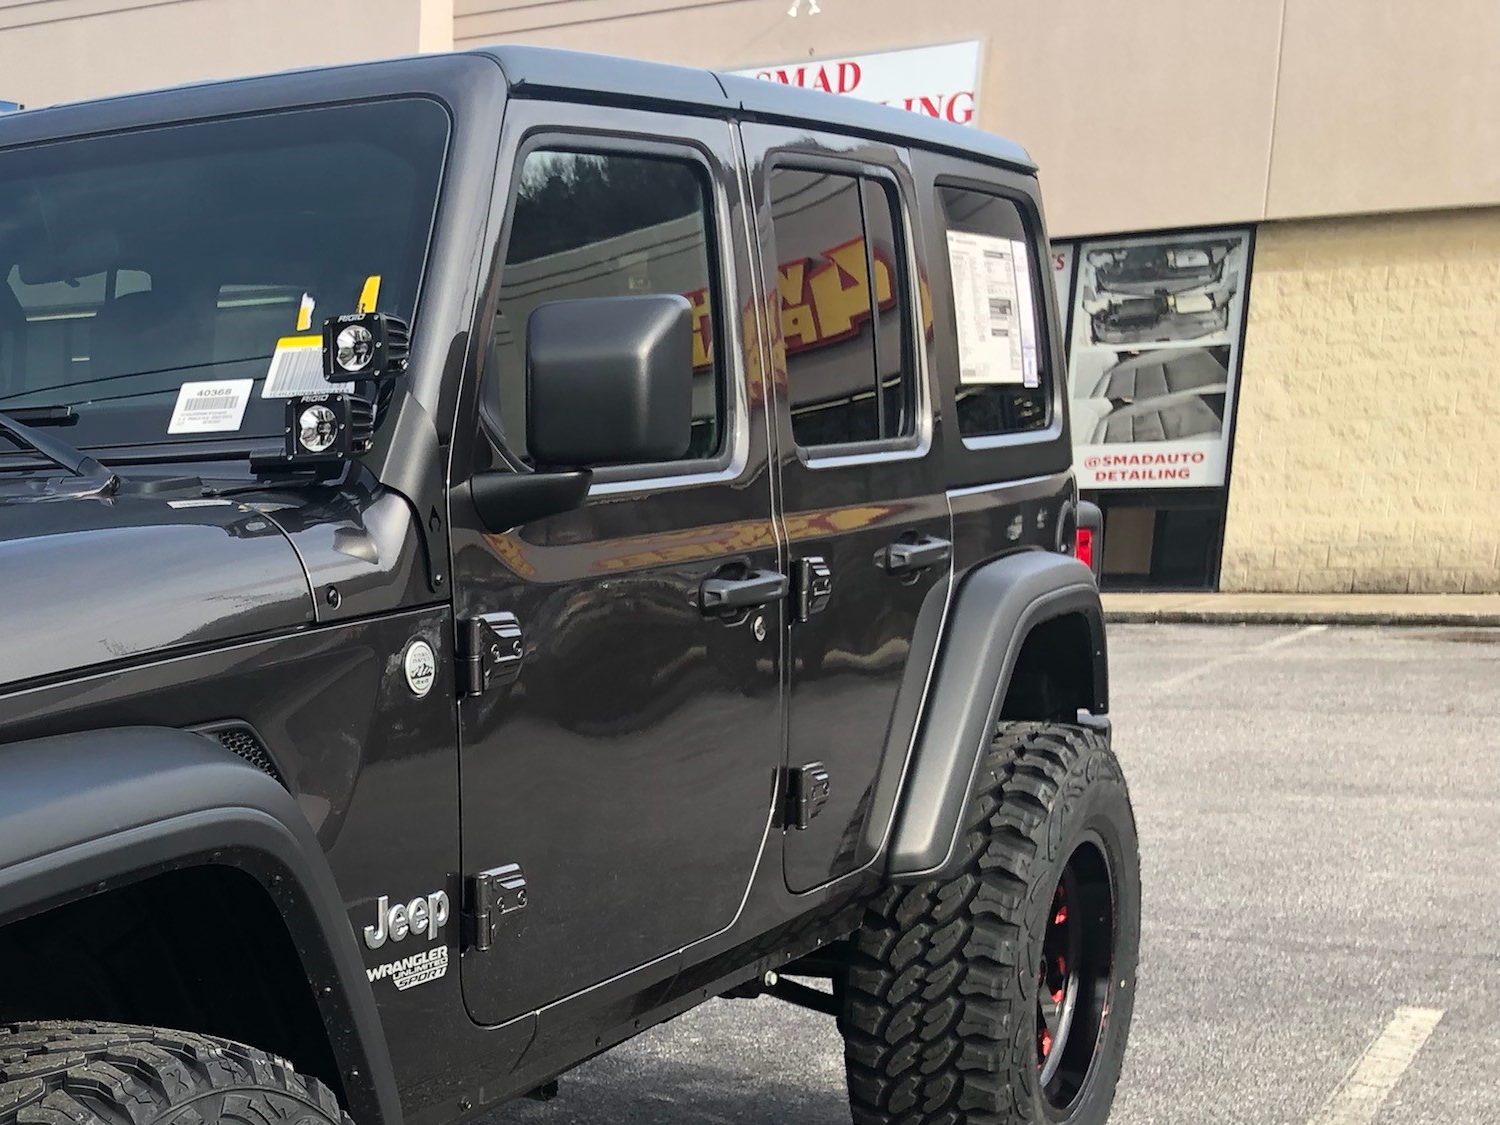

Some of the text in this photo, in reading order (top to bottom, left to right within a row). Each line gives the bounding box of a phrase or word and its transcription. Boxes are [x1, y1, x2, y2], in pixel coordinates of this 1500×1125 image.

[756, 61, 861, 94] MAD
[301, 394, 329, 403] RIGID
[1084, 451, 1204, 470] @SMADAUTO
[1095, 468, 1190, 482] DETAILING
[364, 889, 449, 949] Jeep
[366, 945, 448, 982] WRANGLER
[393, 956, 448, 980] UNLIMITED
[398, 968, 446, 988] SPORT
